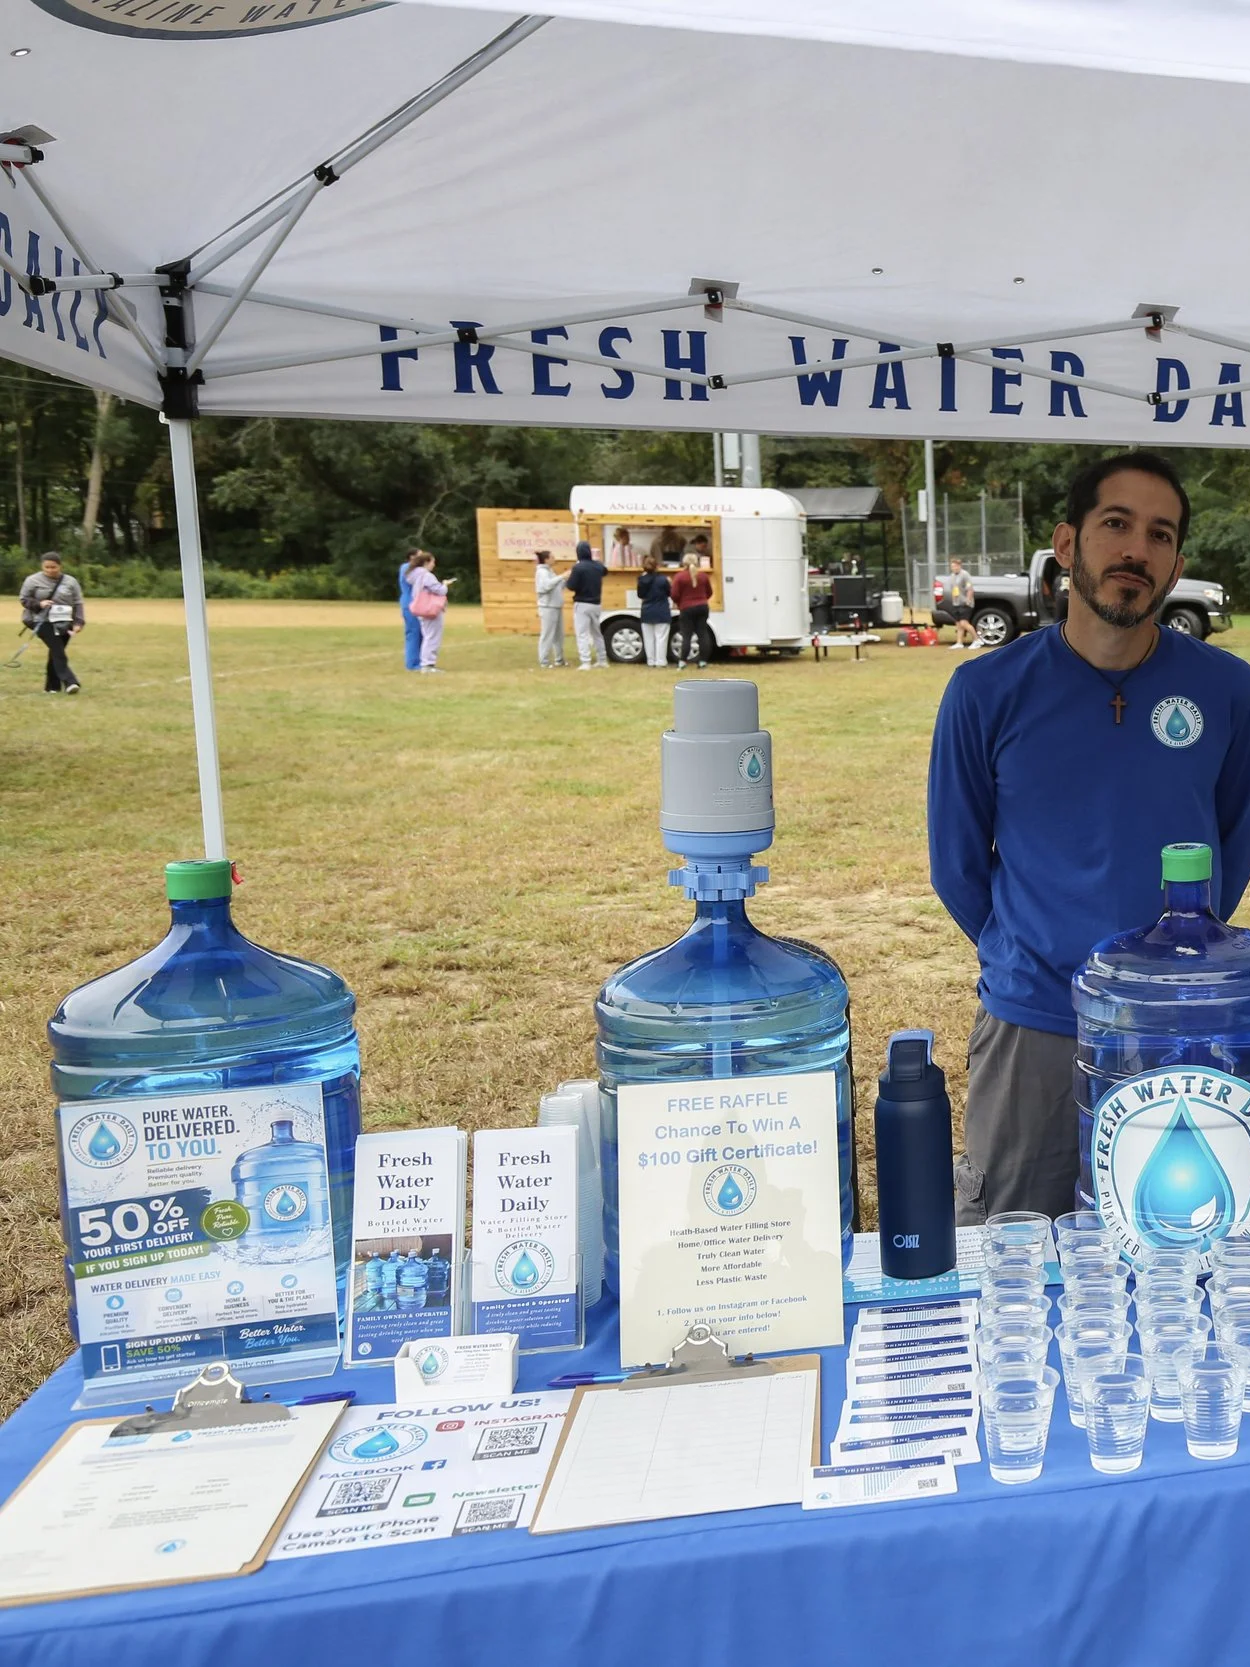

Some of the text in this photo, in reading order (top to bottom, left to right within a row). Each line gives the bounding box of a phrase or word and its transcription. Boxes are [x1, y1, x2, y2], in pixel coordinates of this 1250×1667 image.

[92, 0, 368, 24] ALINE WATE
[378, 320, 710, 403] FRESH
[788, 335, 1088, 419] WATER
[1153, 698, 1203, 725] FRESH WATER DAILY
[667, 1092, 788, 1112] FREE RAFFLE
[88, 1114, 118, 1123] WATER
[142, 1104, 233, 1125] PURE WATER.
[1097, 1096, 1129, 1172] FRESH
[1132, 1074, 1234, 1105] WATER
[144, 1118, 241, 1142] DELIVERED.
[655, 1116, 801, 1140] Chance To Win A
[145, 1137, 222, 1161] TO YOU.
[638, 1140, 818, 1169] $100 Gift Certificate!
[377, 1151, 433, 1169] Fresh
[497, 1150, 552, 1167] Fresh
[148, 1173, 179, 1181] Premium
[376, 1173, 434, 1190] Water
[497, 1172, 553, 1188] Water
[705, 1166, 755, 1195] FRESH WATER DAILY
[379, 1195, 431, 1212] Daily
[500, 1196, 550, 1212] Daily
[79, 1196, 184, 1247] 50%
[153, 1217, 190, 1235] OFF
[367, 1216, 444, 1227] Bottled Water
[383, 1224, 429, 1234] Delivery
[480, 1218, 506, 1226] Water
[509, 1215, 541, 1225] Filling
[498, 1222, 561, 1233] Bottled Water
[720, 1219, 792, 1232] Water Filling Store
[505, 1231, 543, 1239] Delivery
[677, 1233, 784, 1249] Home/Office Water Delivery
[83, 1232, 194, 1260] YOUR FIRST DELIVERY
[696, 1247, 766, 1261] Truly Clean Water
[86, 1244, 204, 1274] IF YOU SIGN UP TODAY!
[498, 1241, 553, 1273] FRESH WATER DAILY
[700, 1260, 763, 1273] More Affordable
[91, 1270, 222, 1294] WATER DELIVERY MADE EASY
[696, 1273, 768, 1287] Less Plastic Waste
[481, 1298, 570, 1311] Family Owned Operated
[667, 1306, 693, 1316] Follow
[718, 1300, 759, 1311] Instagram
[771, 1294, 808, 1305] Facebook
[415, 1310, 449, 1318] OPERATED
[708, 1310, 782, 1325] in your info below!
[238, 1323, 306, 1340] Better Water.
[722, 1328, 737, 1336] are
[738, 1324, 771, 1335] entered!
[125, 1334, 193, 1350] SIGN UP TODAY
[244, 1338, 275, 1349] Better
[125, 1344, 182, 1358] SAVE 50%
[376, 1398, 541, 1421] FOLLOW US!
[474, 1412, 568, 1427] INSTAGRAM
[482, 1449, 531, 1460] SCAN ME
[318, 1464, 416, 1481] FACEBOOK
[452, 1482, 542, 1499] Newsletter
[326, 1504, 379, 1516] SCAN ME
[285, 1515, 441, 1542] Use your Phone
[460, 1526, 491, 1535] SCAN
[281, 1526, 436, 1552] Camera to Scan
